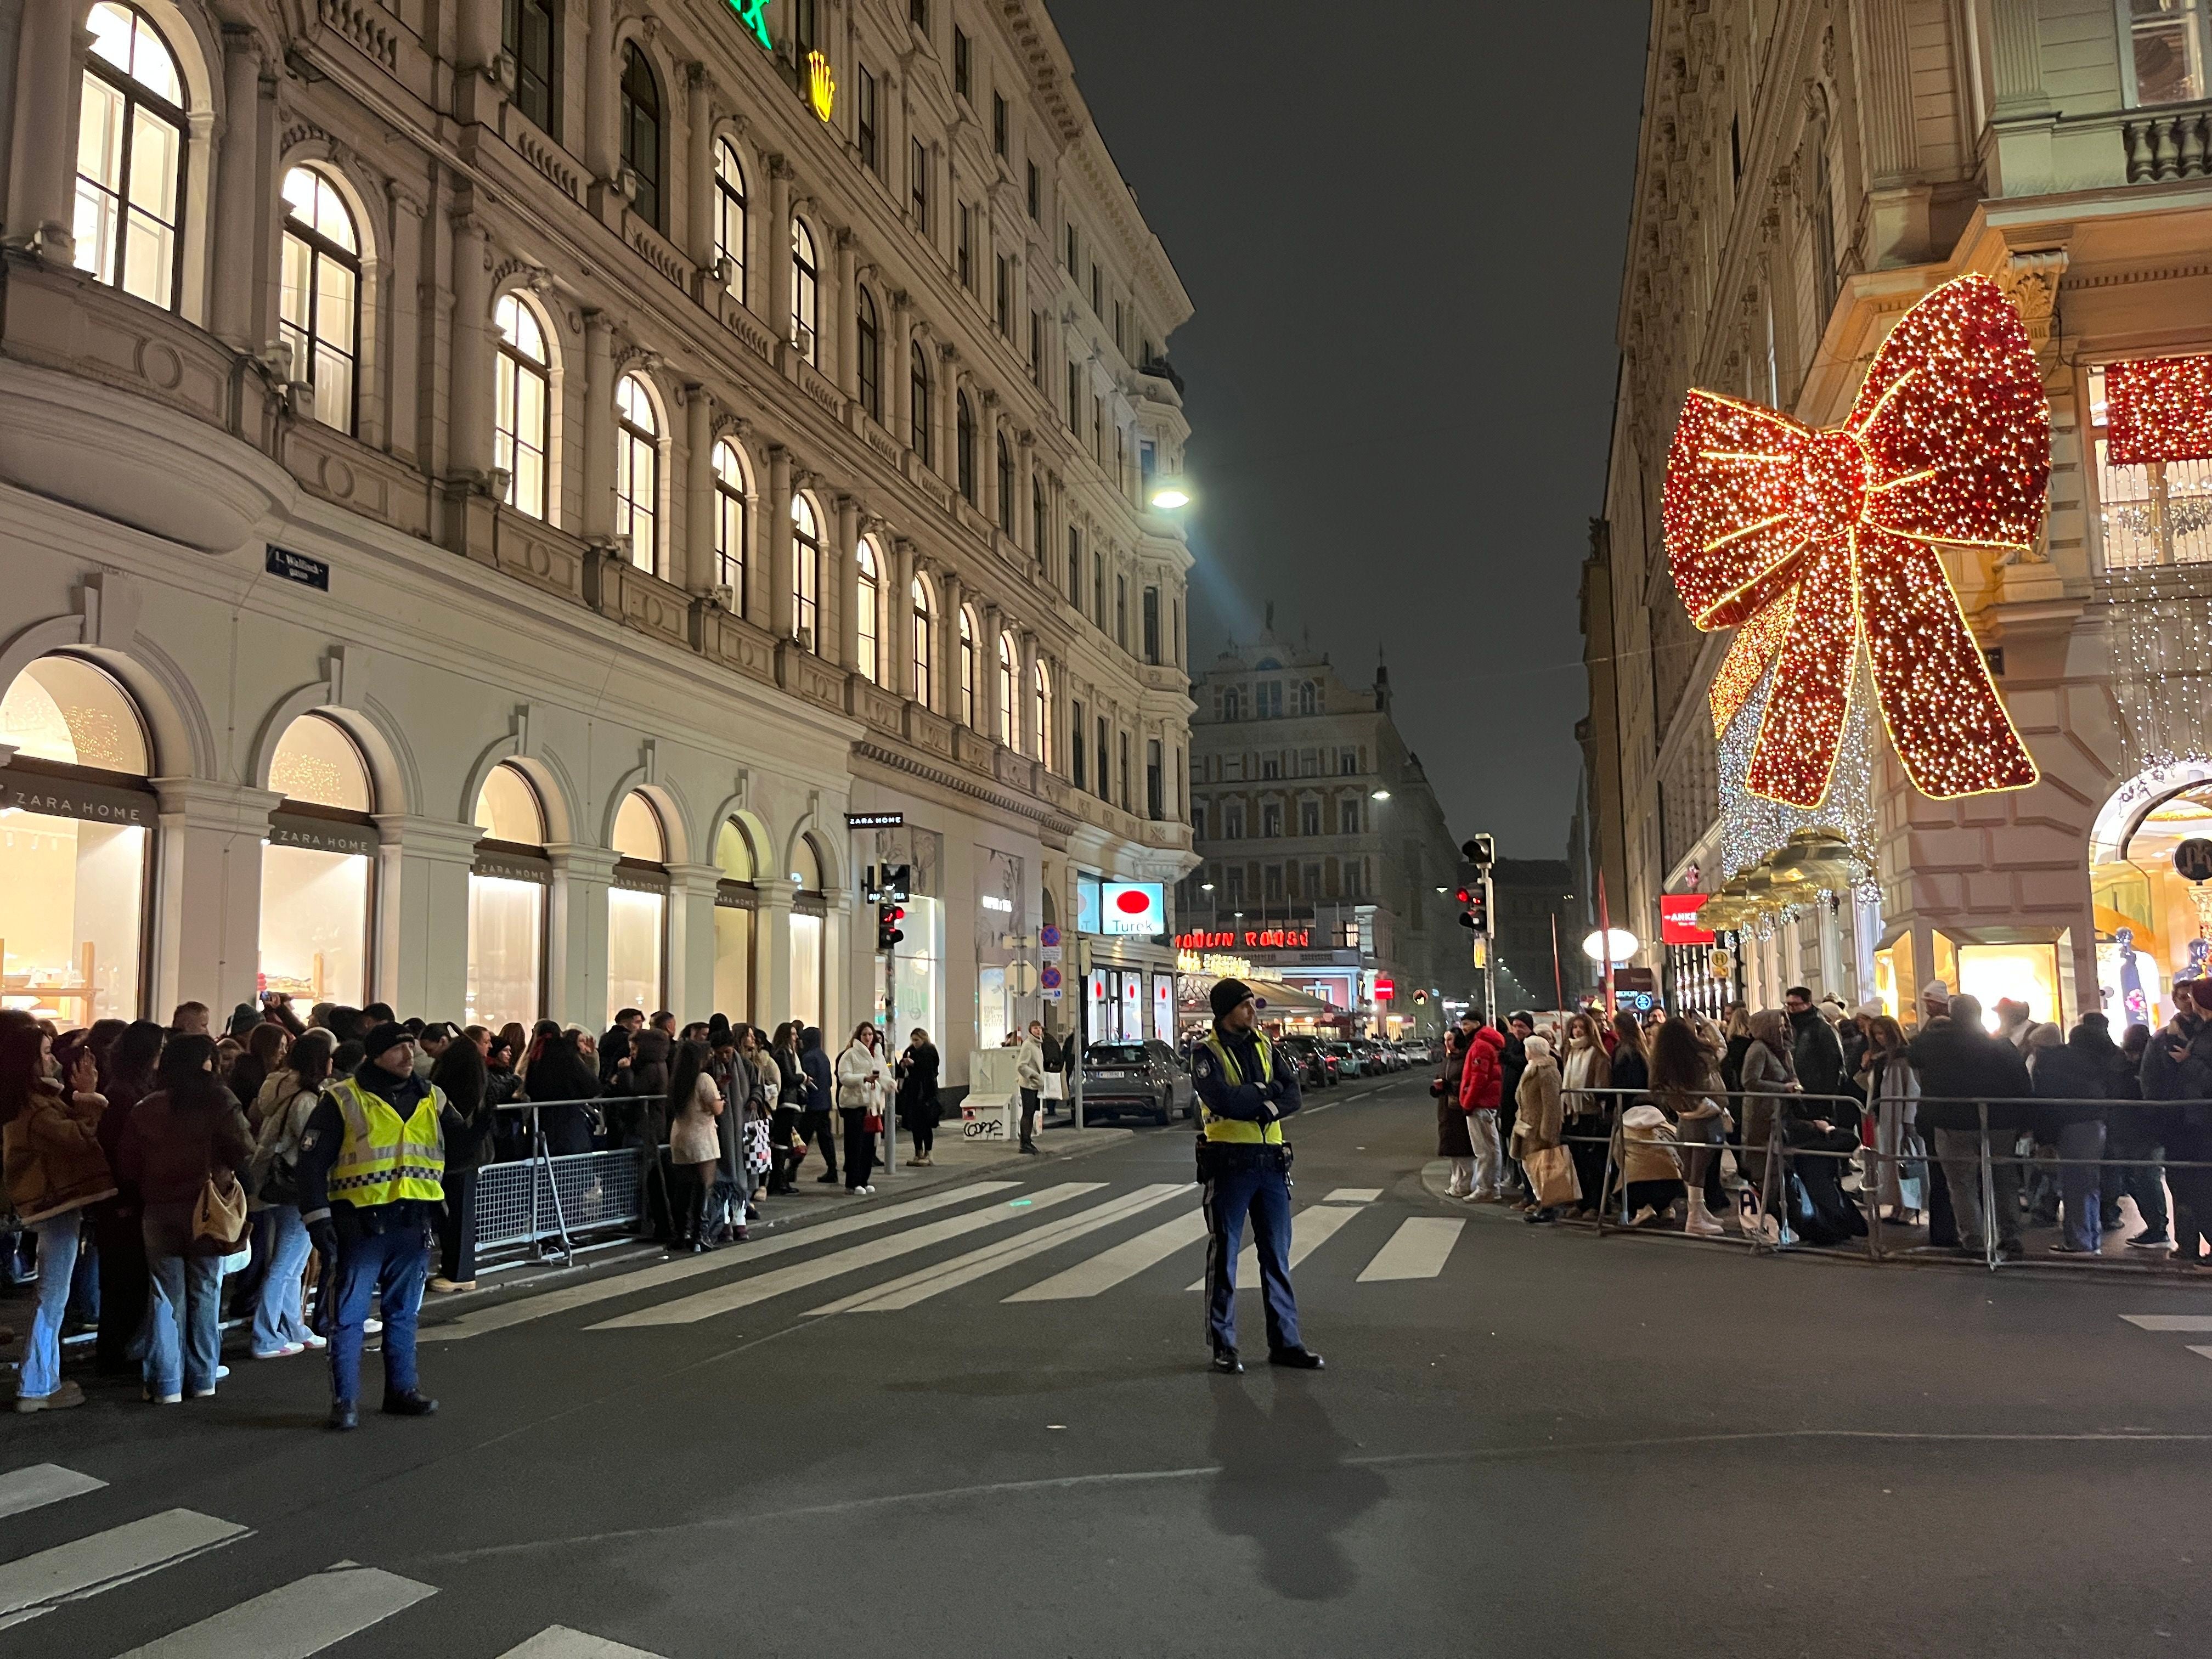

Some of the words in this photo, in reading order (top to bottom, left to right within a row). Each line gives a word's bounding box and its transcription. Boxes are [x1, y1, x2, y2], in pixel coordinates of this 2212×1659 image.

[16, 792, 72, 811] ZARA
[83, 802, 140, 821] HOME
[280, 825, 320, 845] ZARA
[328, 837, 368, 851] HOME
[481, 864, 511, 874] ZARA
[515, 868, 545, 881] HOME
[640, 882, 665, 892] HOME
[1112, 919, 1153, 932] Turek
